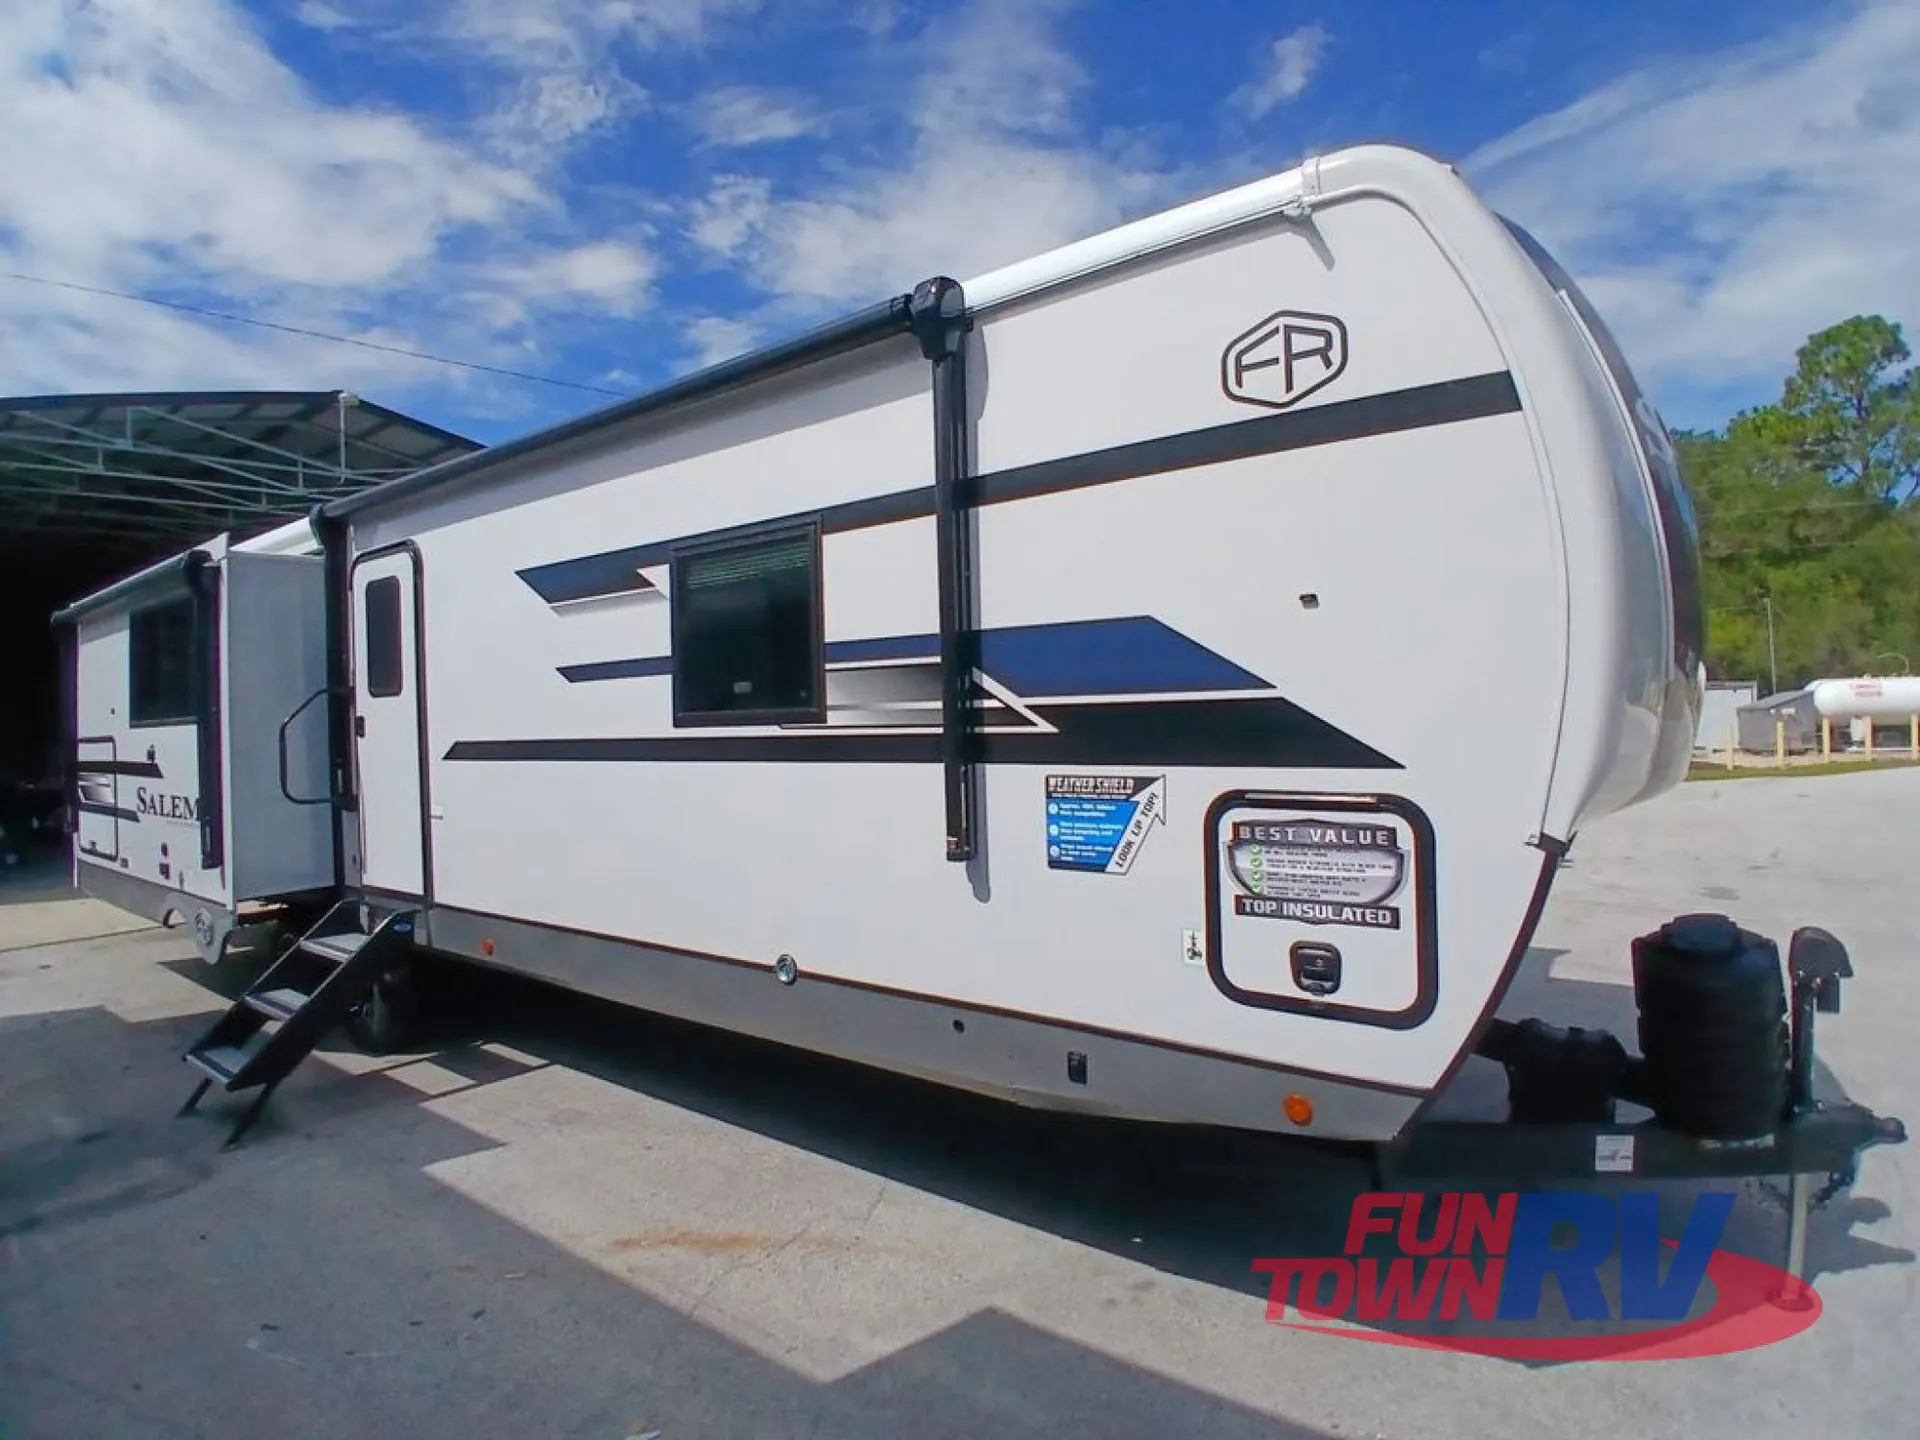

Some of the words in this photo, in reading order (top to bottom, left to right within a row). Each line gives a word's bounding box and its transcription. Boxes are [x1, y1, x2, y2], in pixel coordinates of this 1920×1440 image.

[136, 786, 202, 821] SALEM
[1239, 826, 1297, 841] BEST
[1309, 828, 1390, 845] VALUE
[1242, 900, 1277, 915] TOP
[1282, 902, 1392, 924] INSULATED
